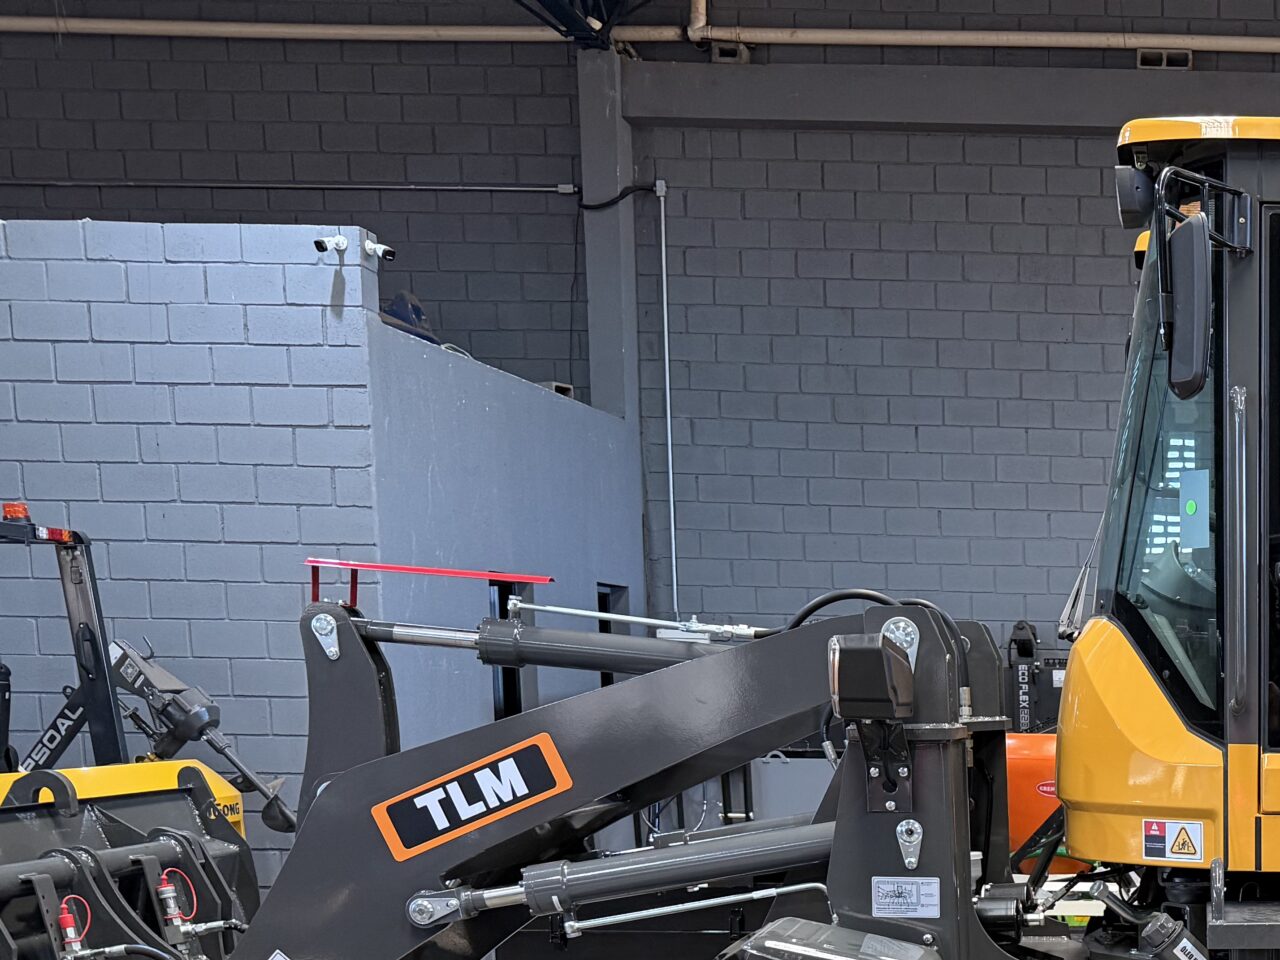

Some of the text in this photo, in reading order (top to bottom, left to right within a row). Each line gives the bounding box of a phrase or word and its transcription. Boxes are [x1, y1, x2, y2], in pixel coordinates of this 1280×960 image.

[1018, 664, 1028, 683] ECO
[1019, 684, 1029, 708] FLEX
[413, 757, 530, 831] TLM
